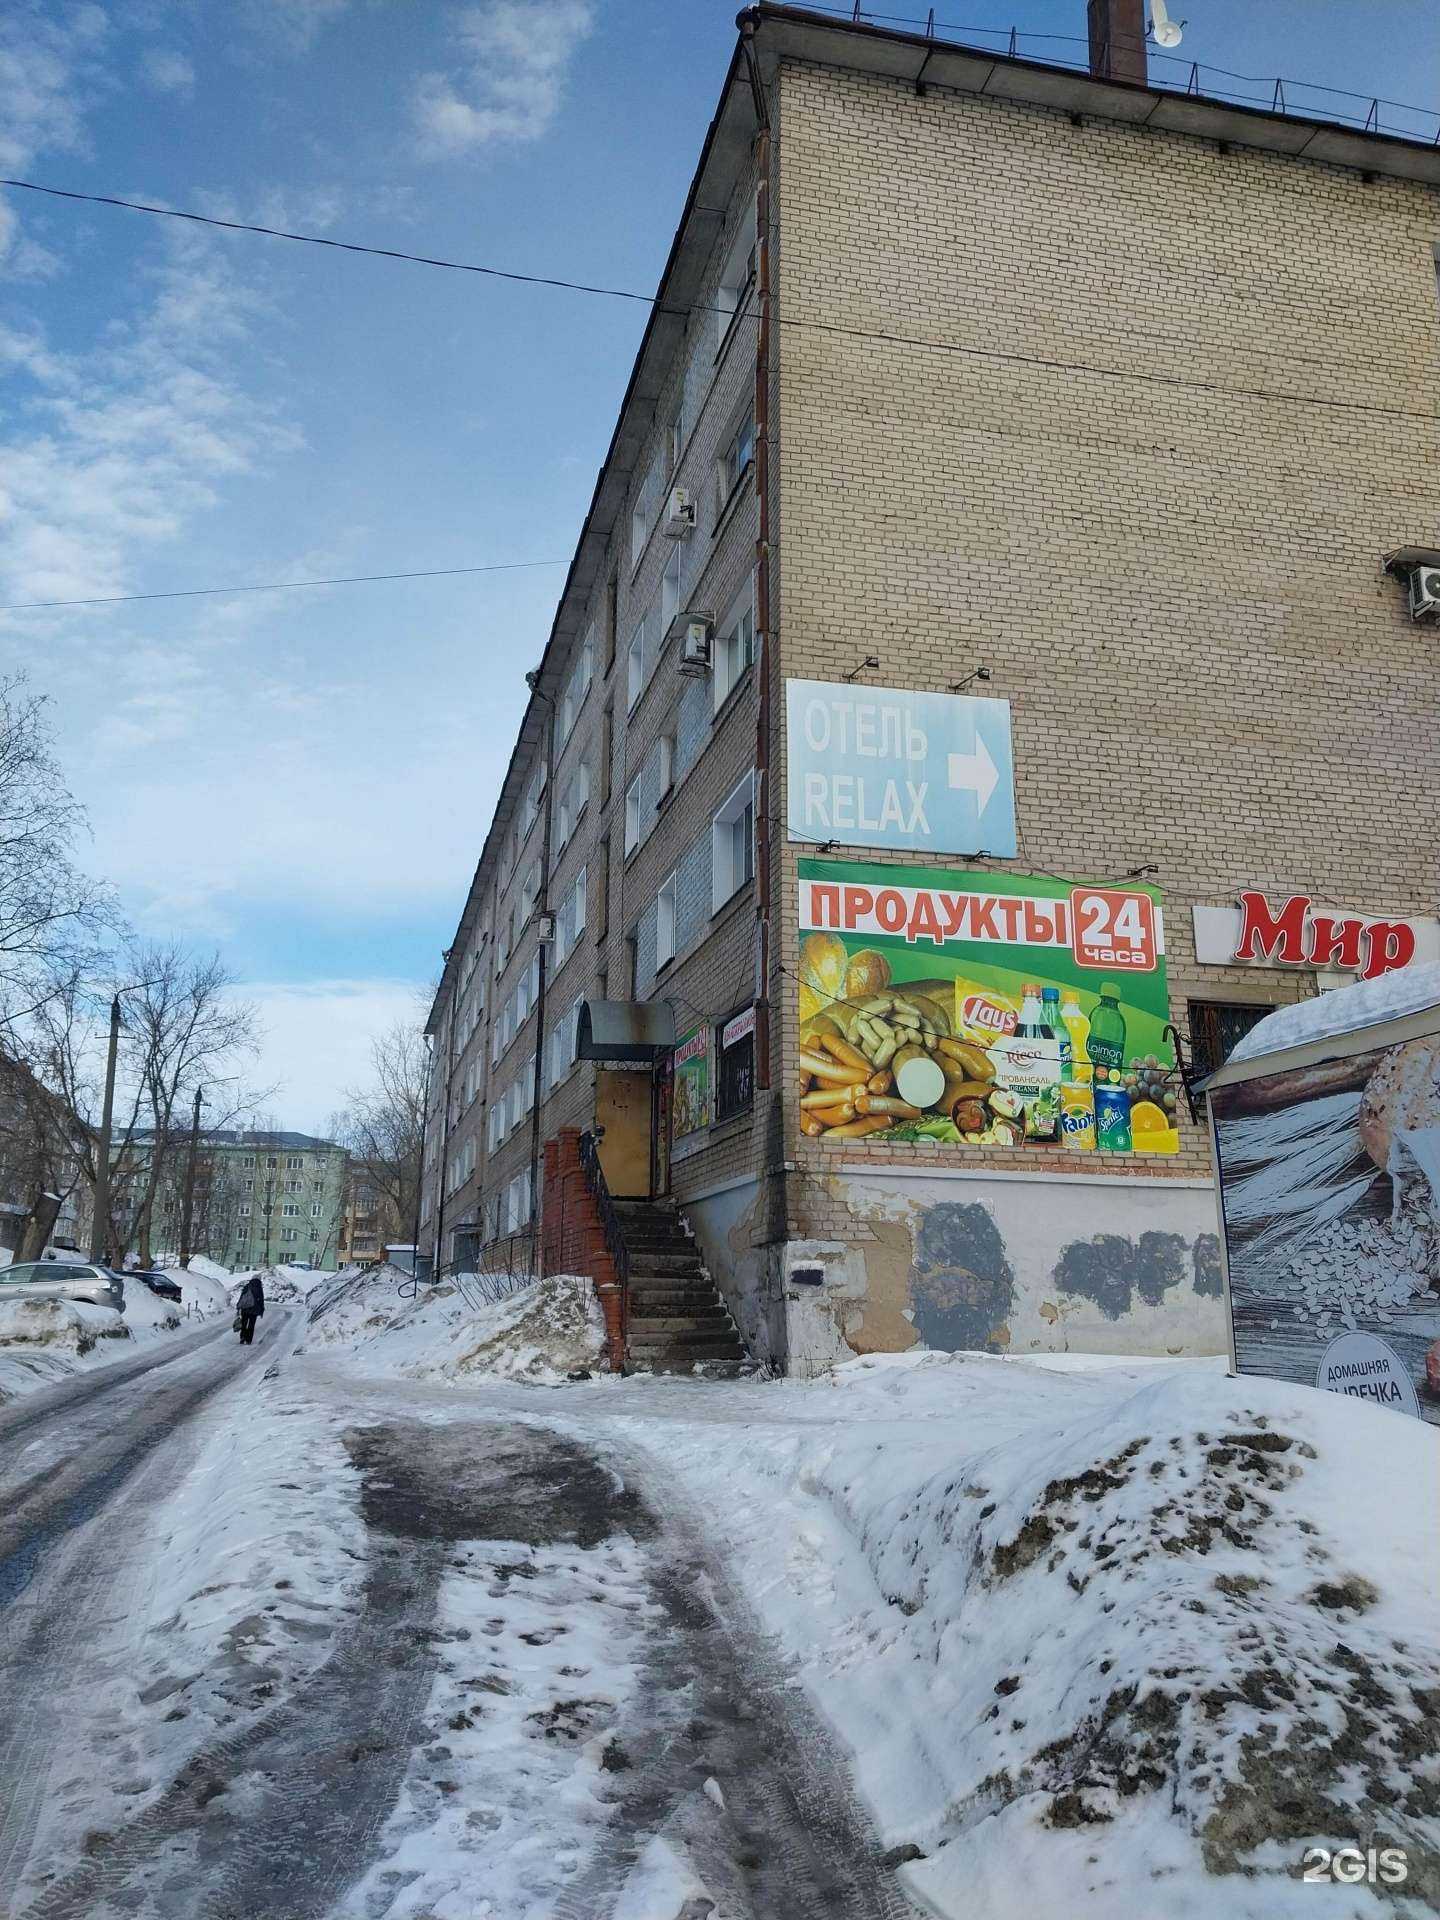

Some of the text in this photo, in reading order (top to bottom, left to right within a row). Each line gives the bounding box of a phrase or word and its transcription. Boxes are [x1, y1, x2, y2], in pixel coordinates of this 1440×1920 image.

[805, 700, 928, 760] ОТЕЛЬ
[805, 773, 931, 834] RELAX
[811, 884, 1146, 949] ПРОДУКТЫ 24
[1235, 892, 1416, 981] Мир
[1084, 948, 1146, 965] часа
[1328, 1359, 1390, 1383] ДОМАШНЯЯ
